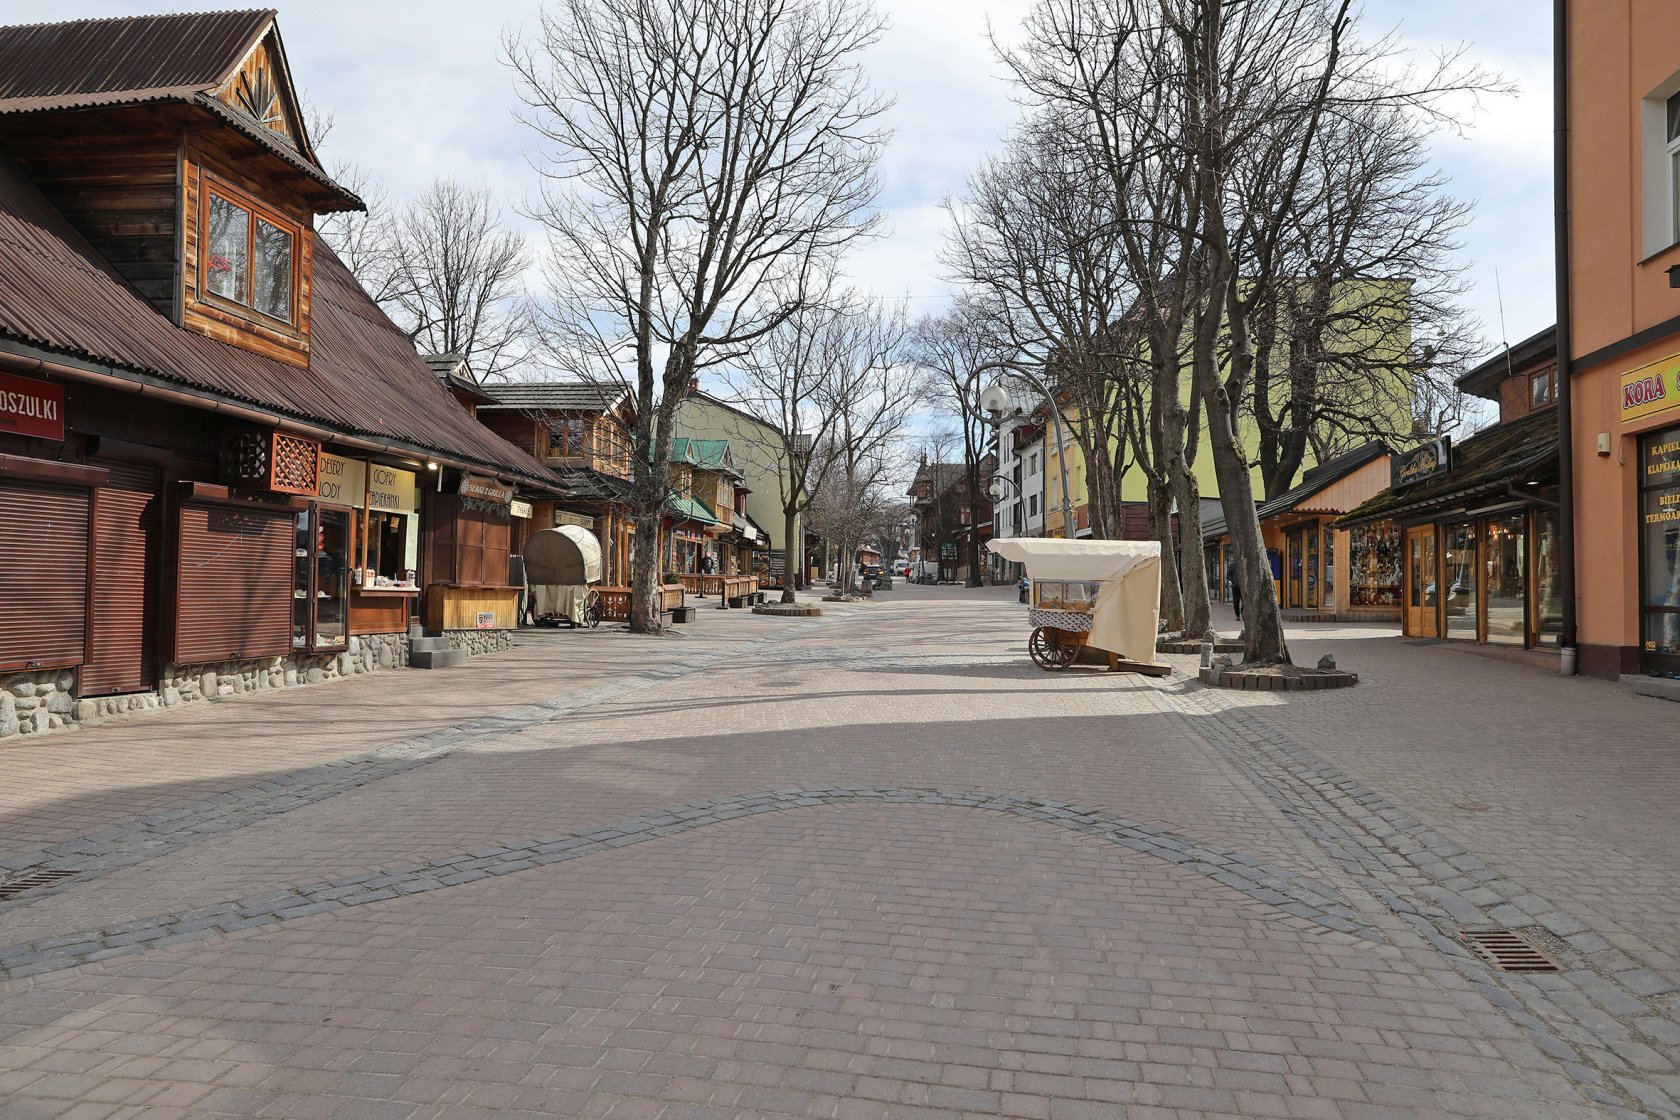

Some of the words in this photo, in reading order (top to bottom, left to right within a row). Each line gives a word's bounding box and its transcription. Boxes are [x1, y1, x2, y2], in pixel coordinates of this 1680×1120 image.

[1623, 373, 1666, 410] KORA
[0, 390, 57, 420] OSZULKI
[320, 457, 346, 477] DESERY
[373, 469, 397, 487] GOFRY
[319, 480, 342, 500] LODY
[488, 488, 505, 499] GRILLA
